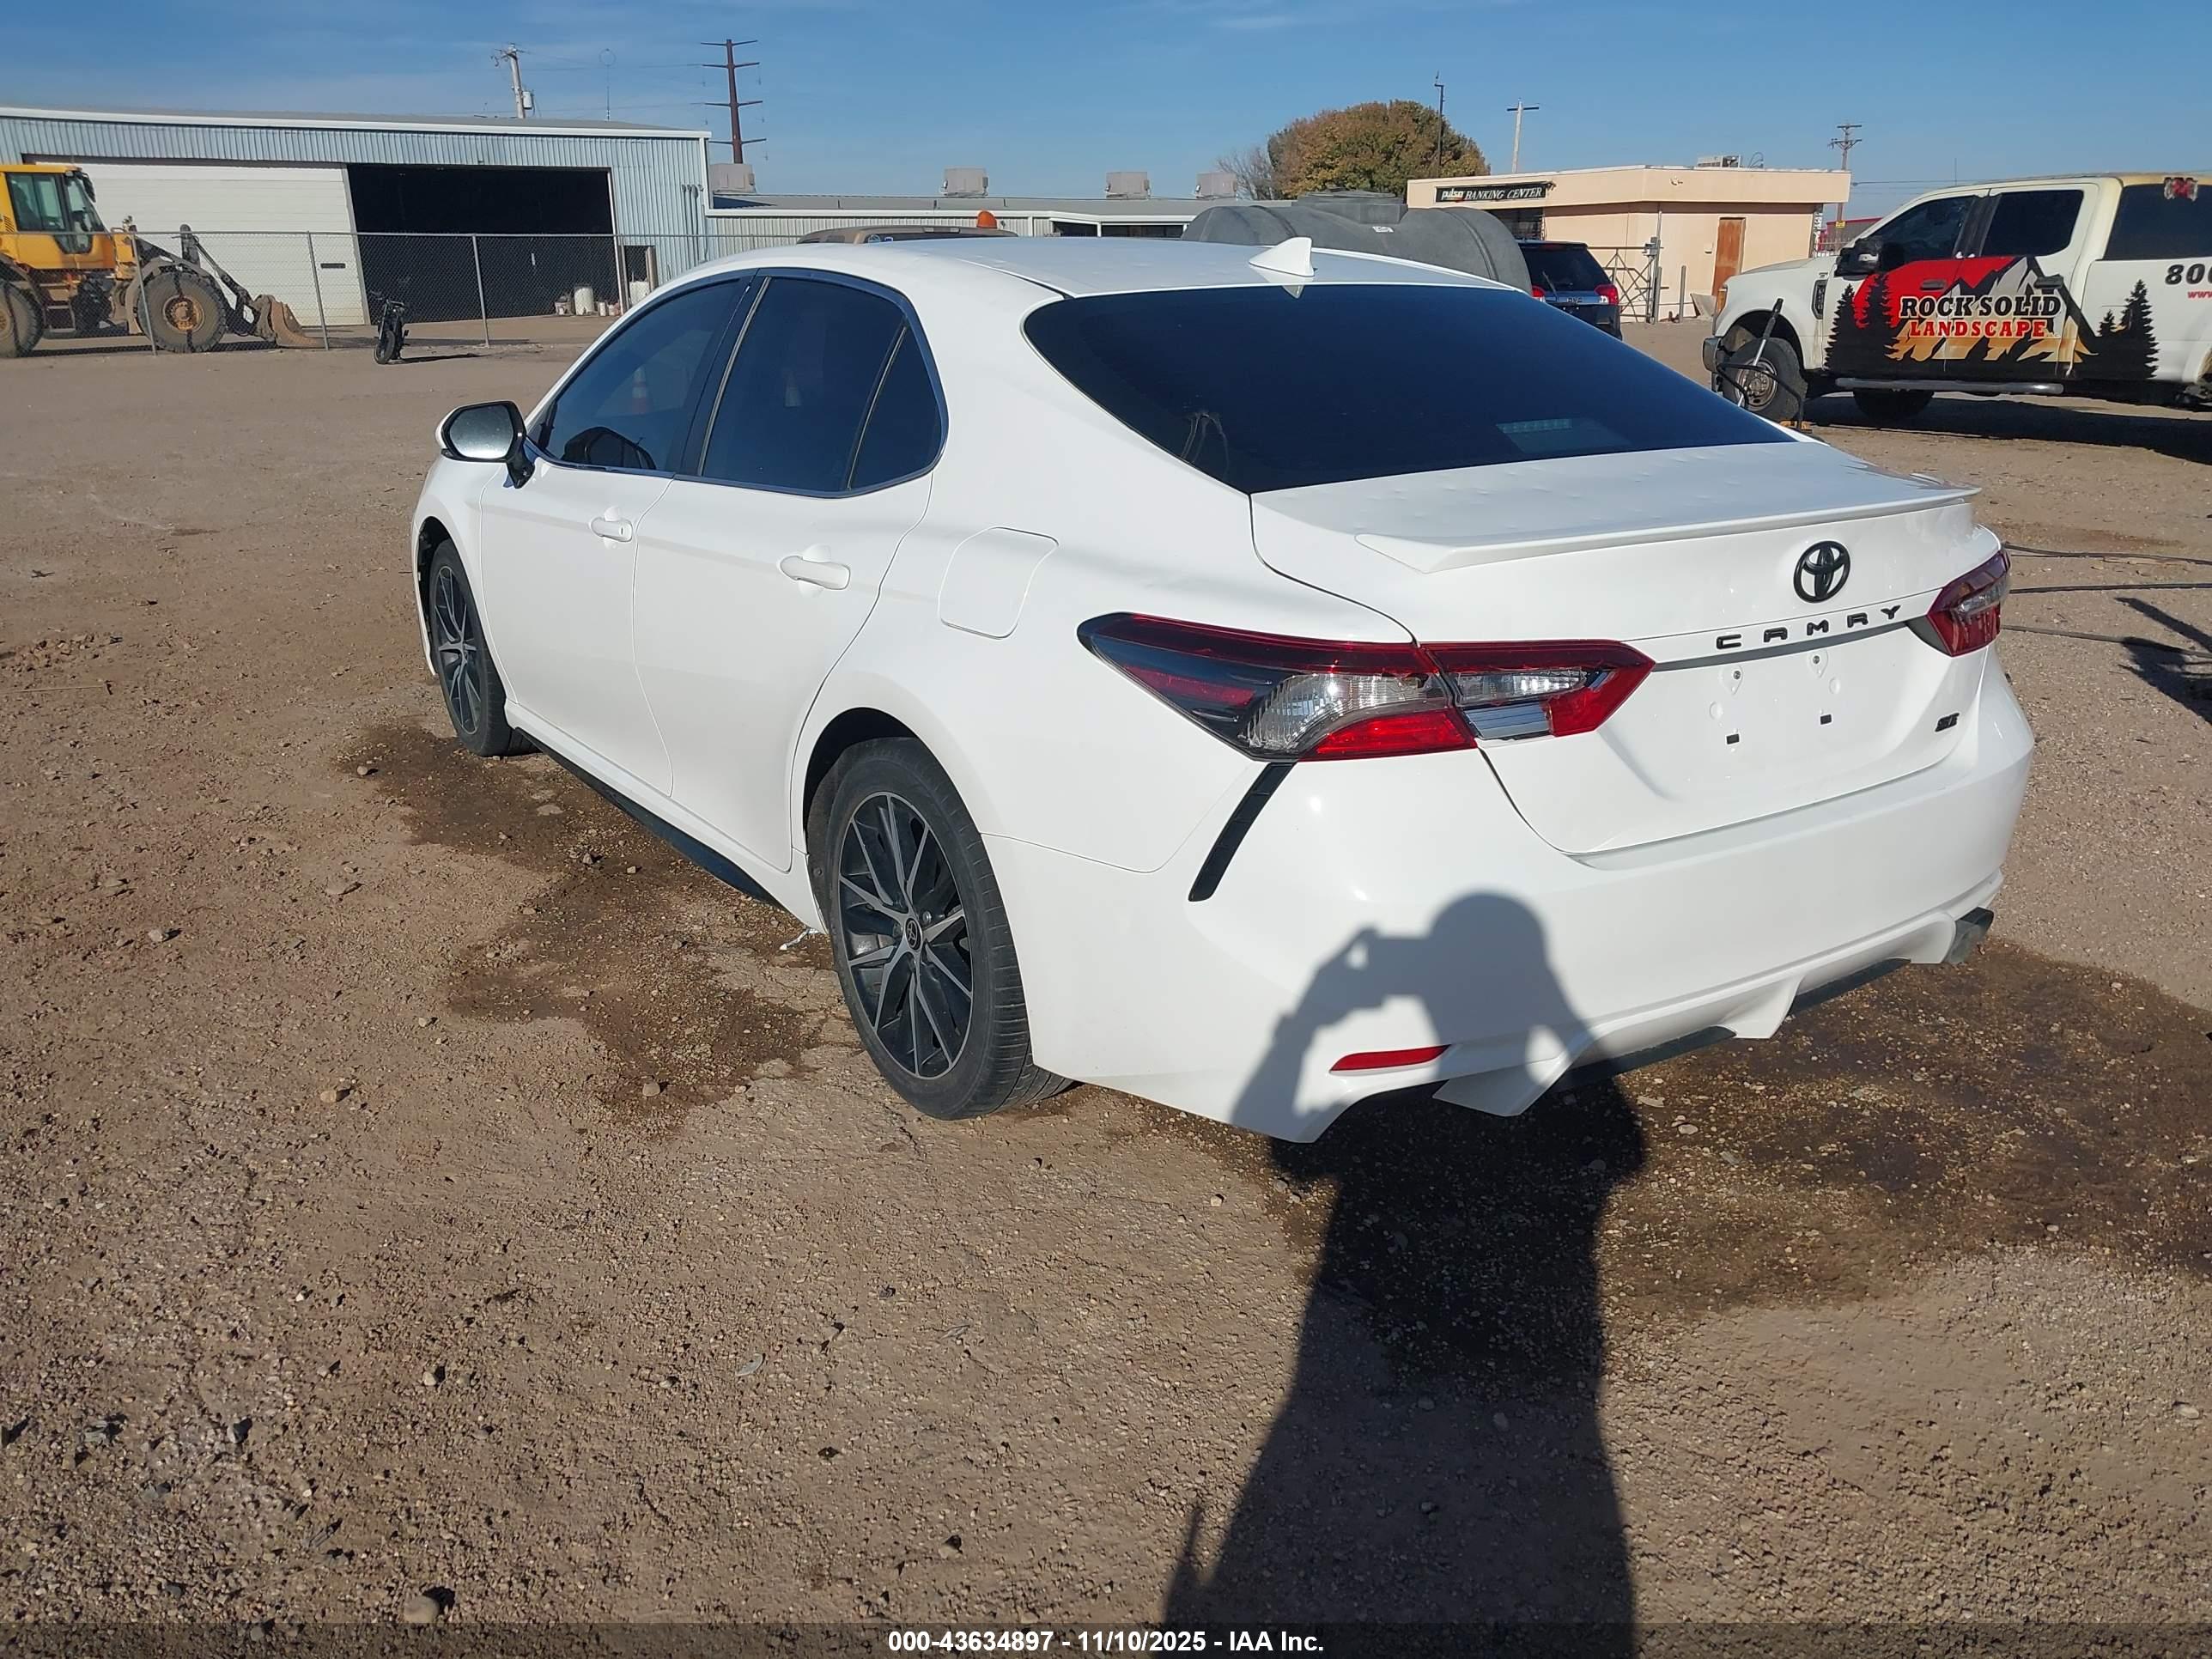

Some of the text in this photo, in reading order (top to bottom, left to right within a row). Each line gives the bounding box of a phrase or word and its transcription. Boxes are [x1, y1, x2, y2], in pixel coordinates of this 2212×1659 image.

[1464, 190, 1504, 200] BANKING
[1507, 187, 1542, 199] CENTER
[2165, 263, 2212, 285] 80
[1900, 296, 2062, 317] ROCK SOLID
[1910, 320, 2046, 337] LANDSCAPE
[1716, 605, 1902, 650] CAMRY
